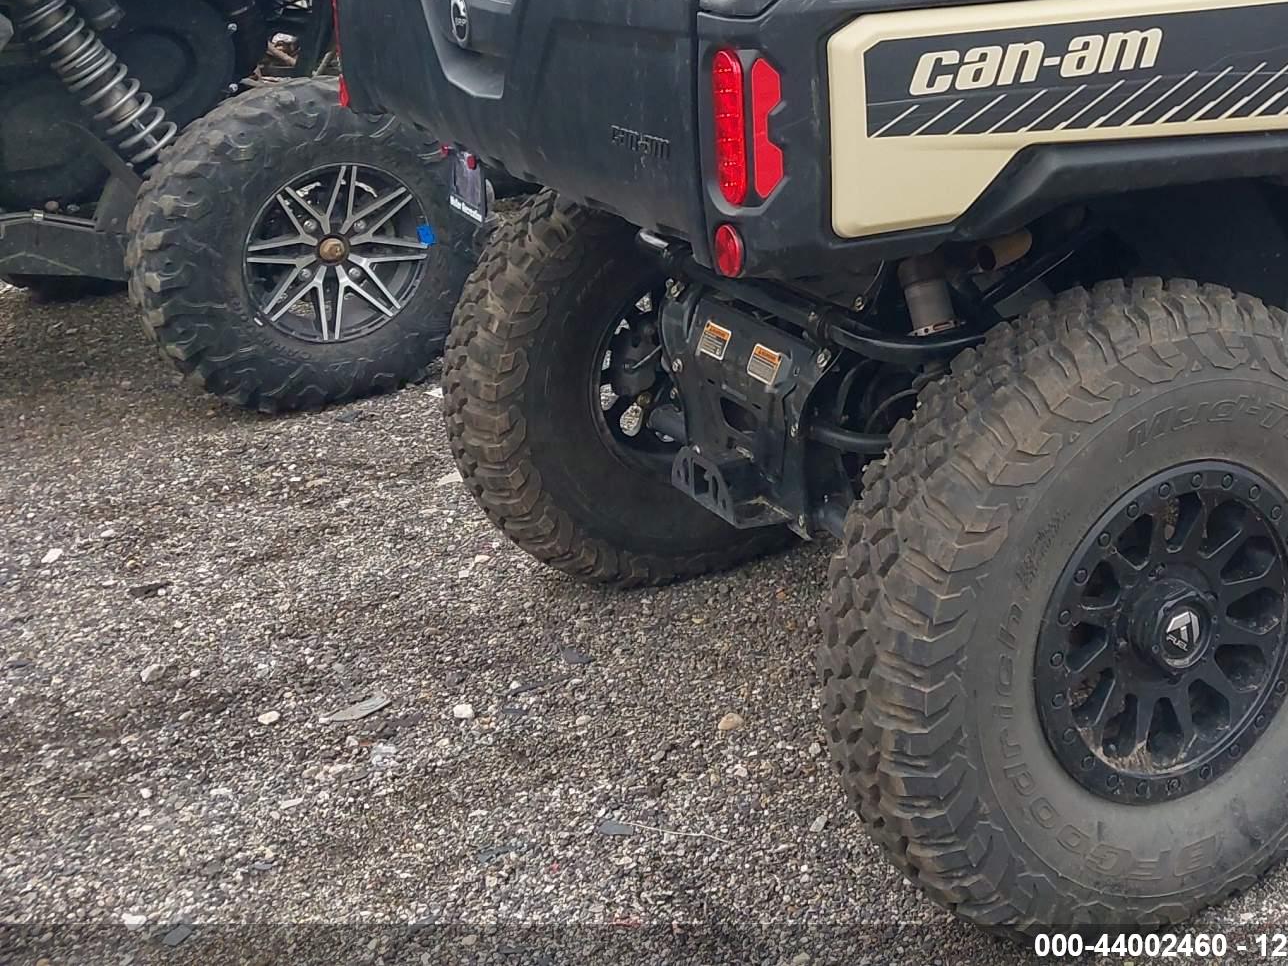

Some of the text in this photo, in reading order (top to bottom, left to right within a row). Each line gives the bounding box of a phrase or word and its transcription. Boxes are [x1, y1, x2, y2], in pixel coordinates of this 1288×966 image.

[909, 27, 1163, 96] can-am
[1166, 634, 1188, 651] FUEL
[993, 601, 1219, 881] BFGoodrich
